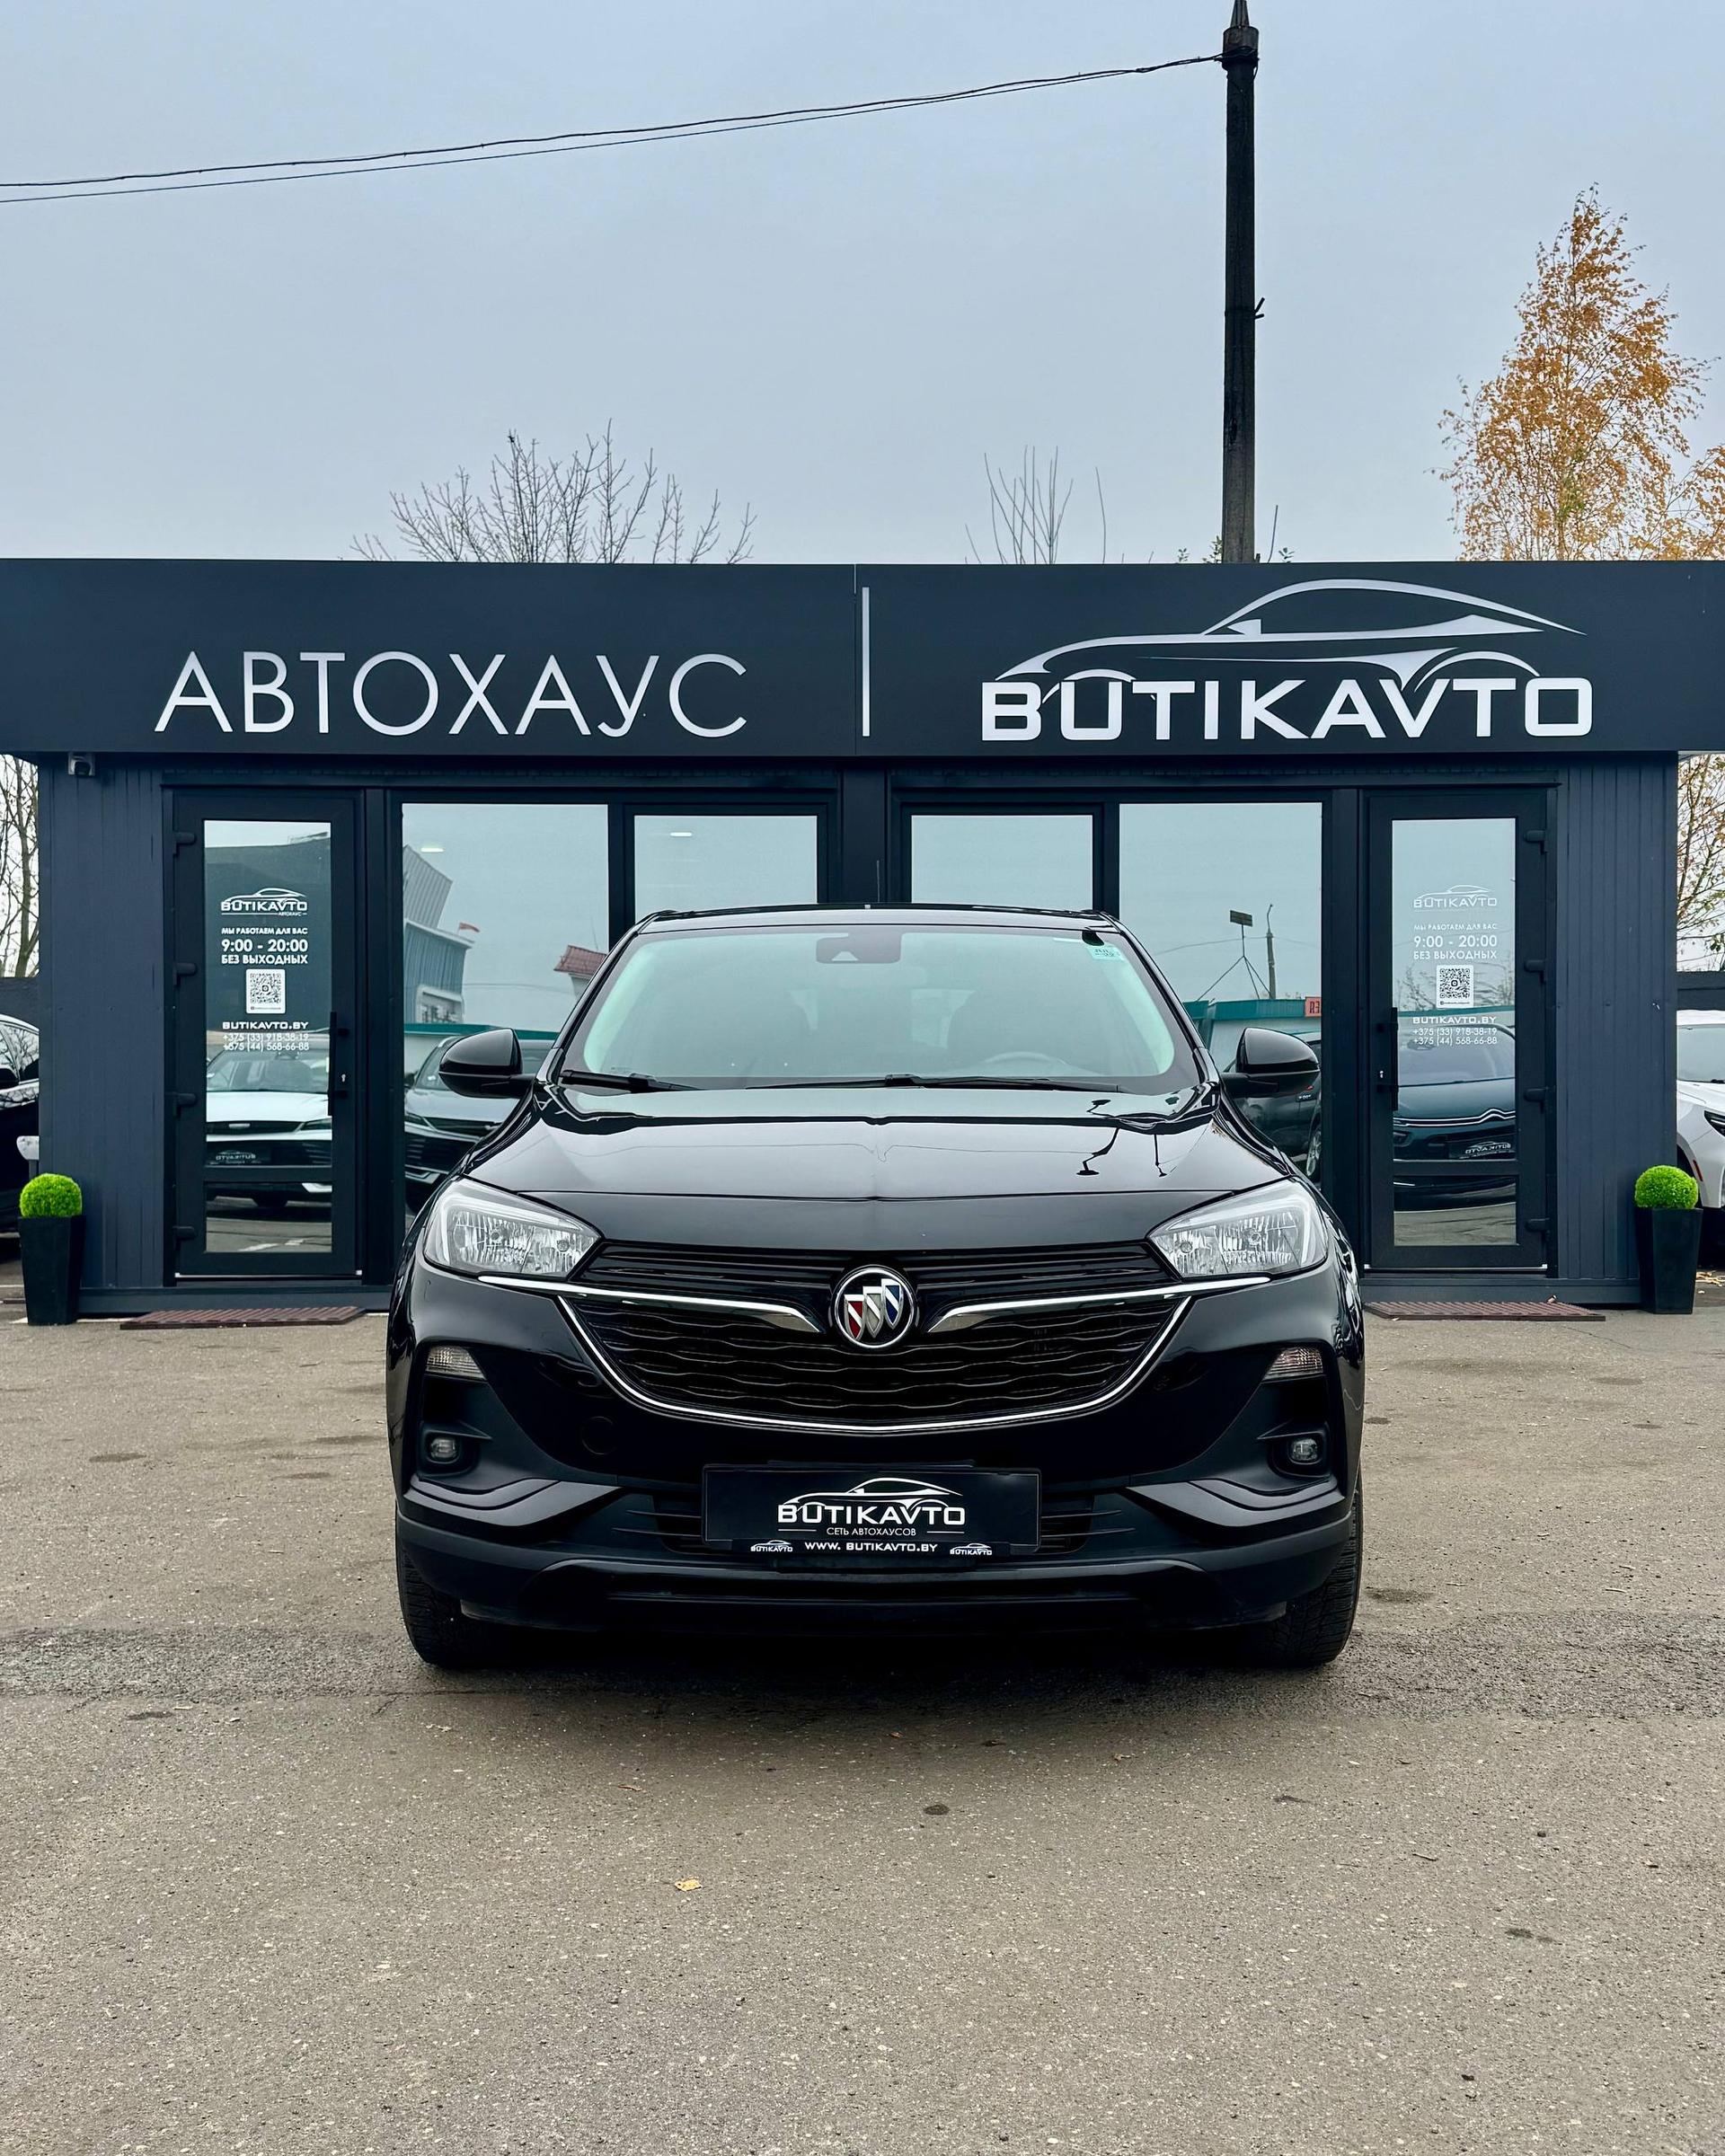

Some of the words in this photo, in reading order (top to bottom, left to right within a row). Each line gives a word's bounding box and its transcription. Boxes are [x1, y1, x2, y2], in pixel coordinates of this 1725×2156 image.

[155, 650, 747, 738] АВТОХАУС
[982, 676, 1592, 741] BUTIKAVTO
[221, 901, 308, 911] BUTIKAVTO
[1413, 897, 1497, 908] BUTIKAVTO
[275, 927, 291, 935] ДЛЯ
[221, 939, 253, 952] 9:00
[268, 939, 308, 952] 20:00
[1413, 935, 1443, 948] 9:00
[1458, 934, 1497, 948] 20:00
[221, 954, 240, 964] БЕЗ
[242, 954, 308, 965] ВЫХОДНЫХ
[1413, 950, 1430, 959] БЕЗ
[1434, 950, 1497, 960] ВЫХОДНЫХ
[222, 1021, 308, 1029] BUTIKAVTO.BY
[1412, 1016, 1497, 1024] BUTIKAVTO.BY
[1412, 1028, 1434, 1036] +375
[1437, 1028, 1453, 1038] (33)
[1455, 1027, 1498, 1036] 918-38-19
[1412, 1037, 1434, 1045] +375
[1437, 1037, 1453, 1047] (44)
[1455, 1036, 1498, 1045] 568-66-88
[777, 1505, 965, 1525] BUTIKAVTO
[826, 1527, 850, 1535] СЕТЬ
[851, 1527, 916, 1536] АВТОХАУСОВ
[804, 1542, 841, 1551] WWW.
[845, 1542, 938, 1552] BUTIKAVTO.BY
